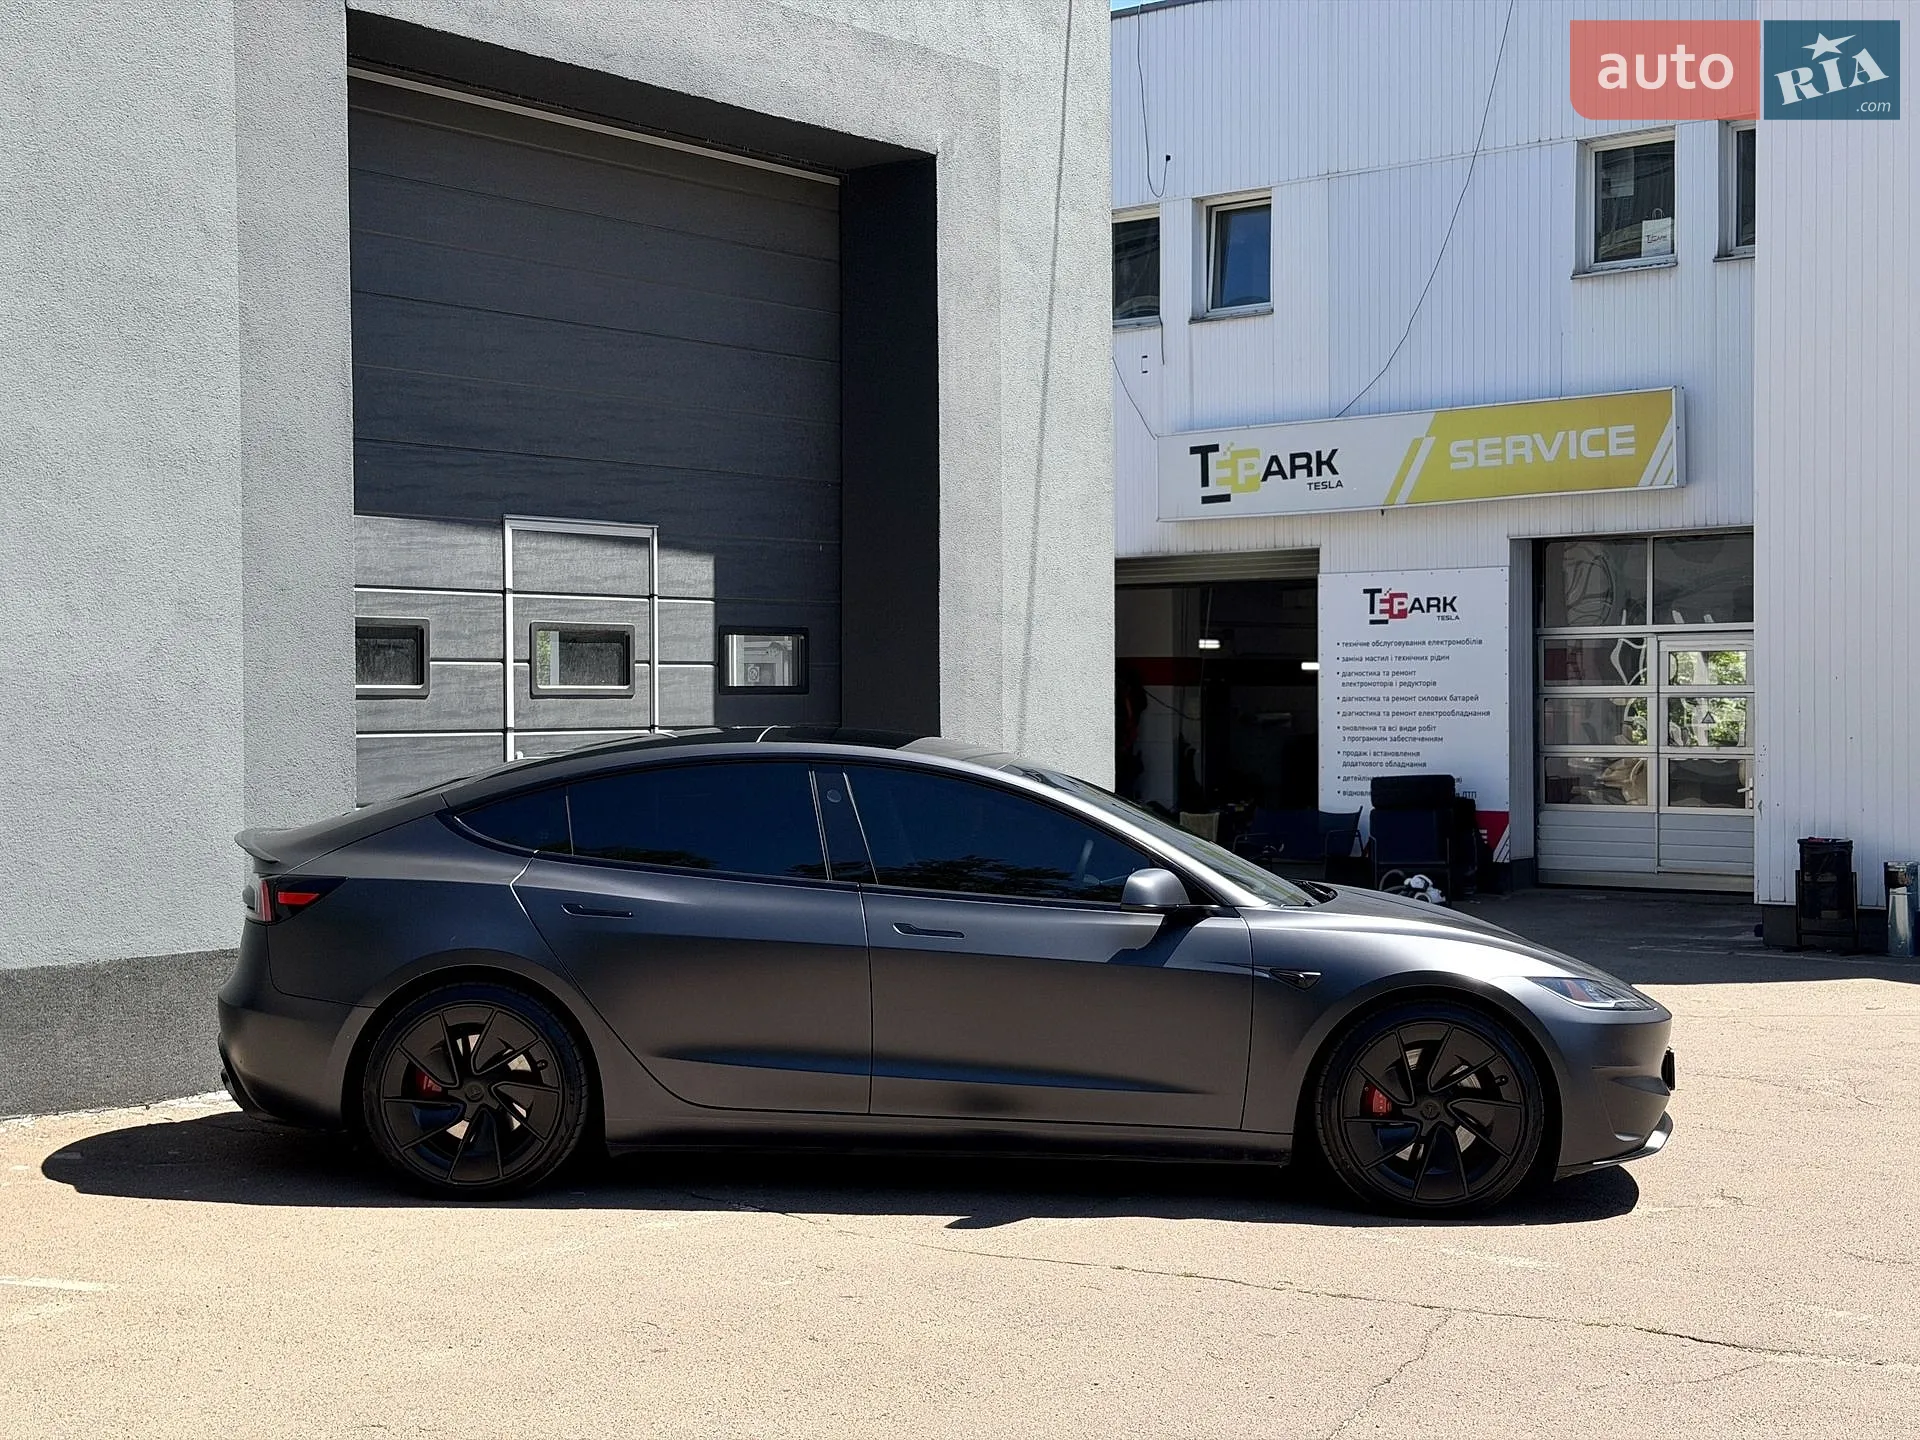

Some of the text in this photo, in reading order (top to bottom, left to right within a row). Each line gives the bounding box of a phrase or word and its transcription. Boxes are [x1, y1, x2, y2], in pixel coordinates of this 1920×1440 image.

[1449, 424, 1637, 470] SERVICE
[1306, 479, 1344, 491] TESLA
[1427, 637, 1483, 647] електромобілів
[1341, 654, 1363, 662] заміна
[1395, 653, 1429, 662] технічних
[1430, 653, 1450, 662] рідин
[1391, 670, 1416, 678] ремонт
[1341, 680, 1394, 688] електромоторів
[1399, 680, 1437, 688] редукторів
[1449, 693, 1479, 702] батарей
[1418, 709, 1491, 718] електрообладнання
[1418, 723, 1436, 733] робіт
[1385, 759, 1427, 768] обладнання
